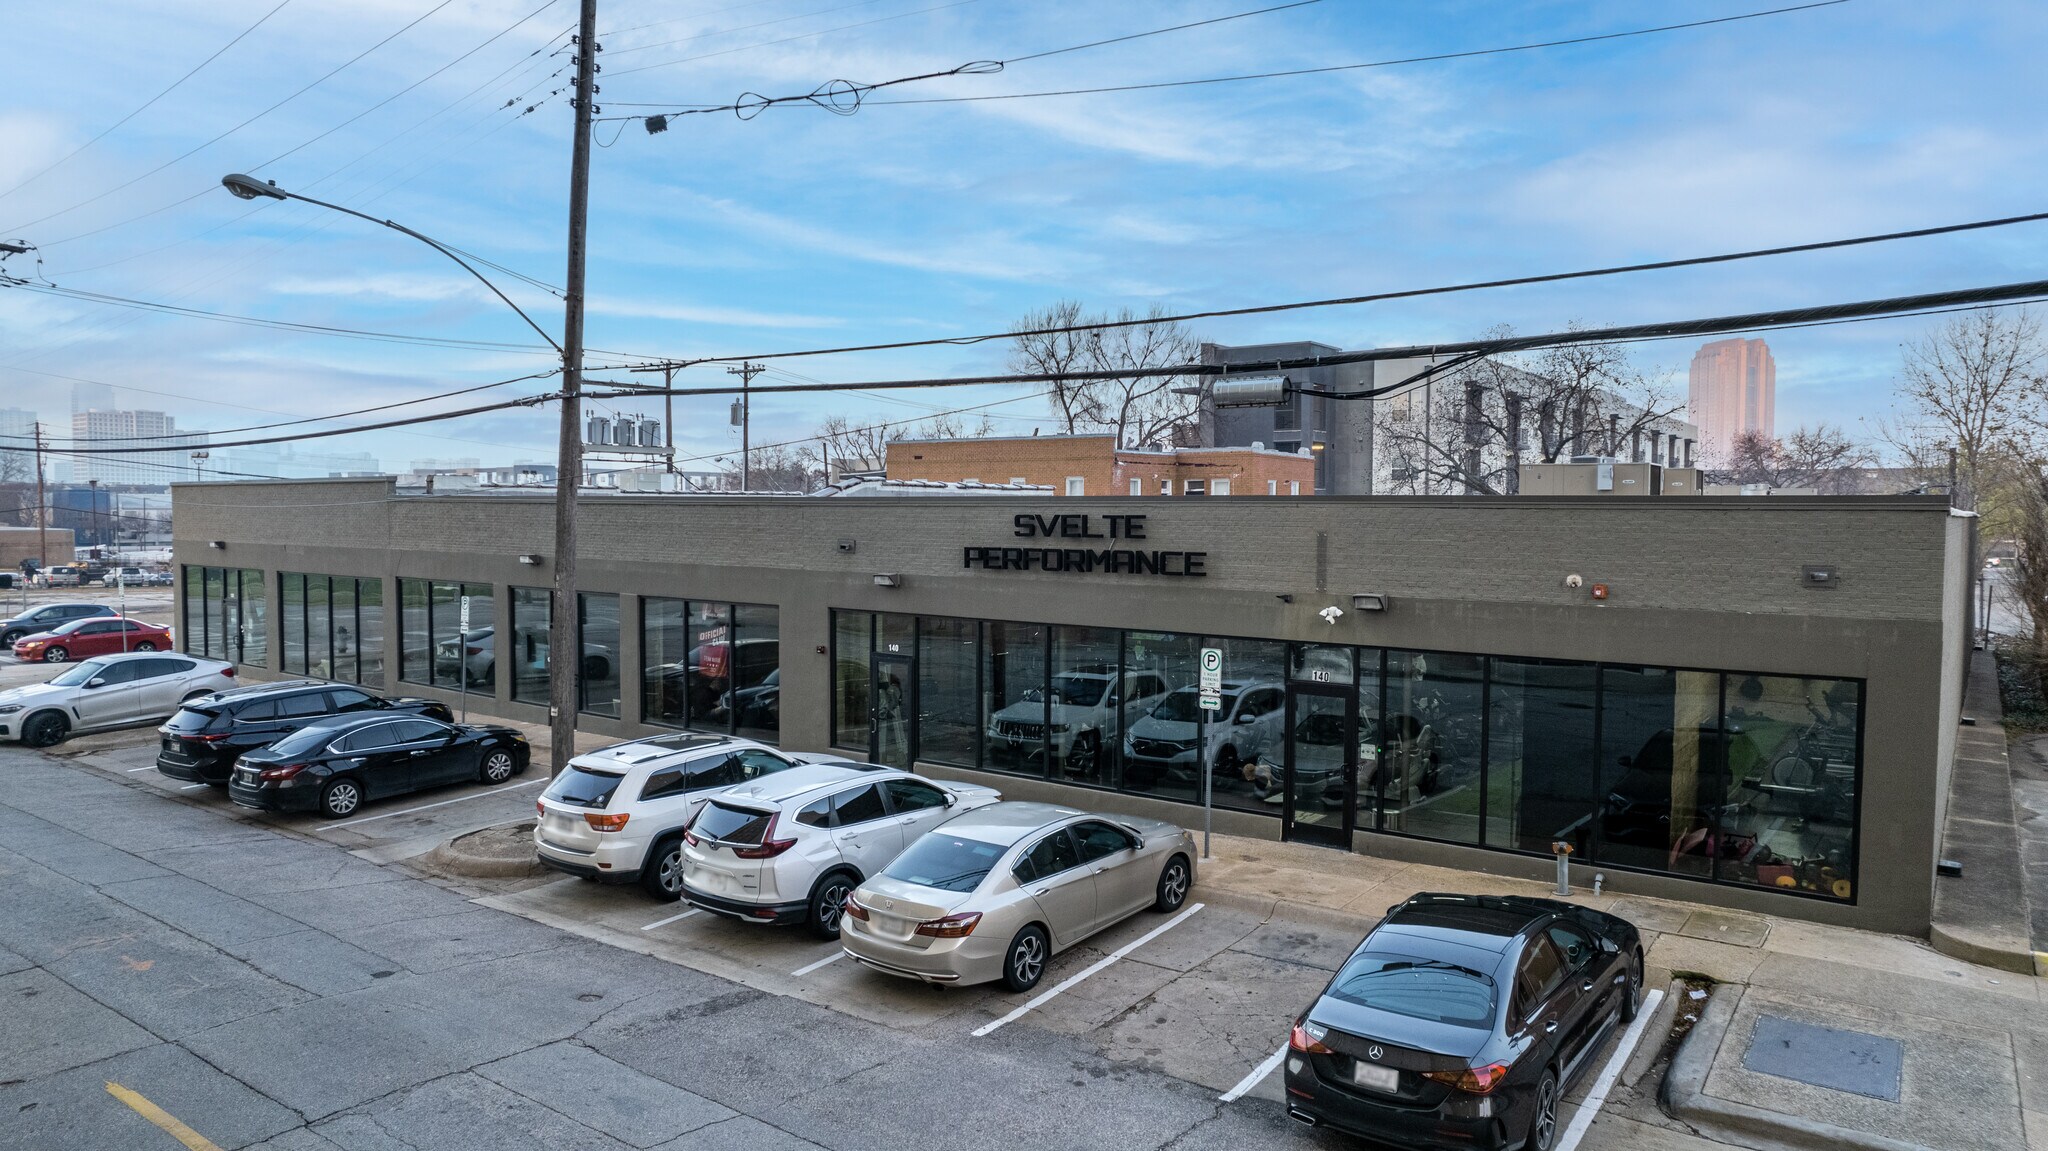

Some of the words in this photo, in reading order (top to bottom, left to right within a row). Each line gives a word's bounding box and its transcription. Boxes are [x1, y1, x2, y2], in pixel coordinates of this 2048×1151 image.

[1014, 514, 1147, 539] SVELTE
[963, 546, 1207, 576] PERFORMANCE
[888, 644, 899, 652] 140
[1207, 654, 1216, 667] P
[1313, 671, 1329, 682] 140
